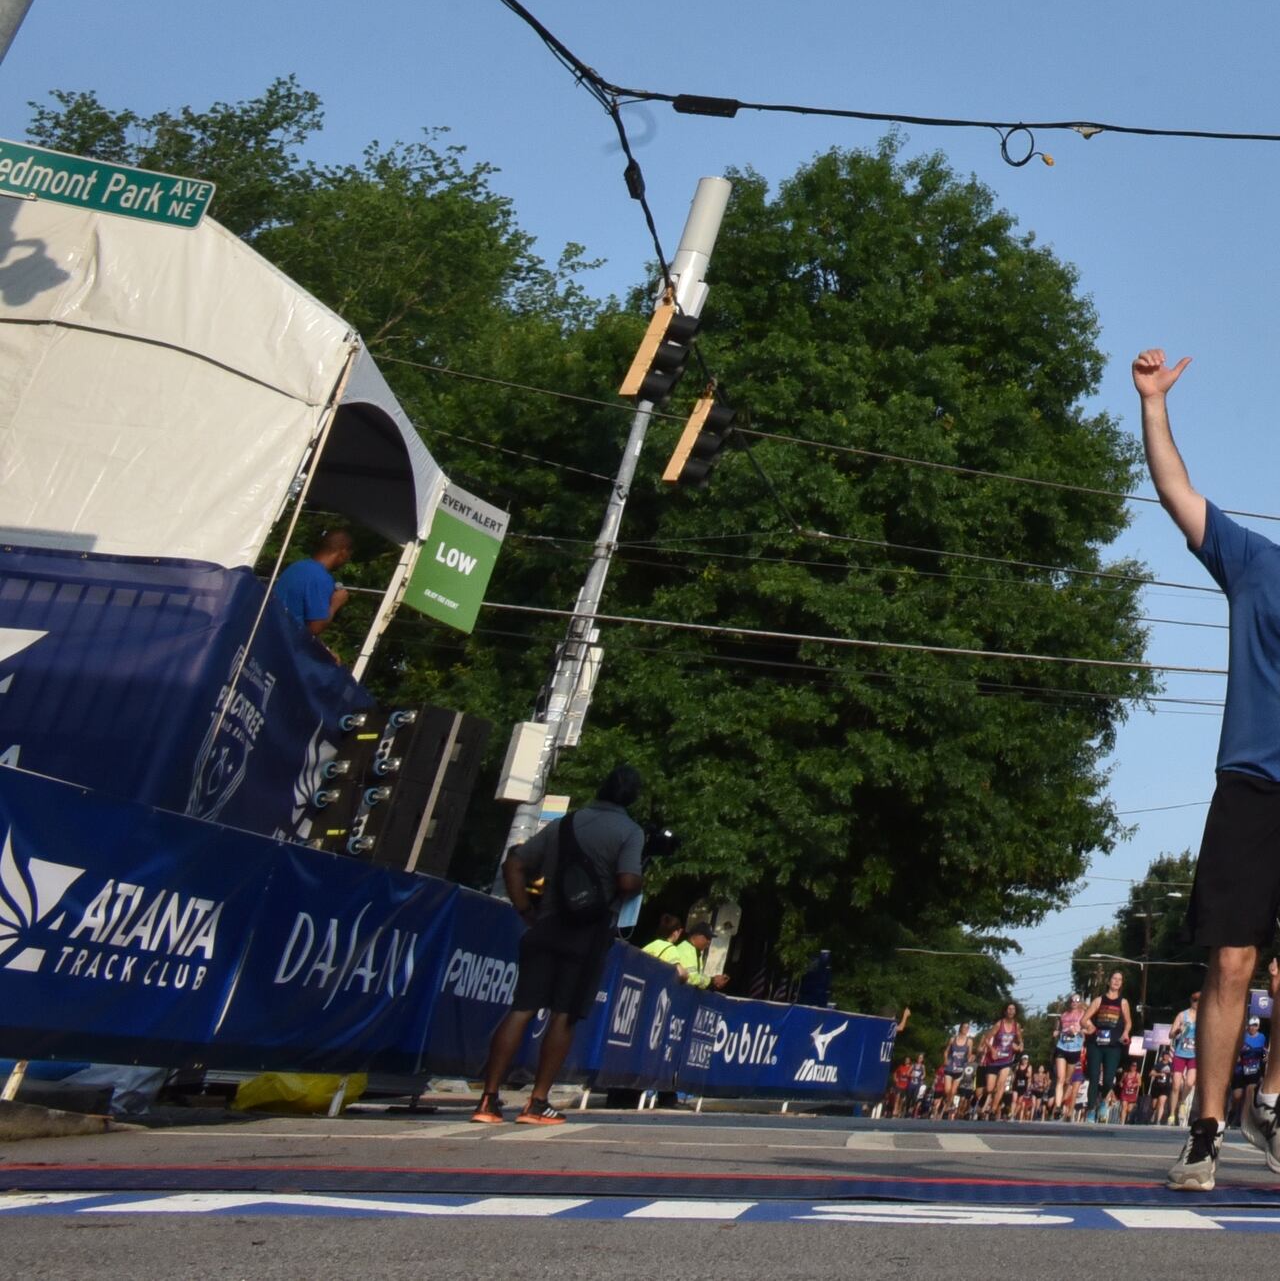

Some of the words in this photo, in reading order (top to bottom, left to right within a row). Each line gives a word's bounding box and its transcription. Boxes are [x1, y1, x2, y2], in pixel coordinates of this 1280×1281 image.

[0, 155, 99, 201] edmont
[101, 173, 165, 214] Park
[170, 180, 211, 202] AVE
[167, 200, 196, 220] NE
[442, 494, 472, 517] EVENT
[472, 511, 503, 533] ALERT
[435, 542, 477, 575] LOW
[69, 879, 225, 960] ATLANTA
[53, 946, 138, 983] TRACK
[143, 959, 208, 991] CLUB
[273, 901, 419, 1011] DASANI
[440, 948, 519, 1006] POWERA
[713, 1015, 778, 1065] Publix
